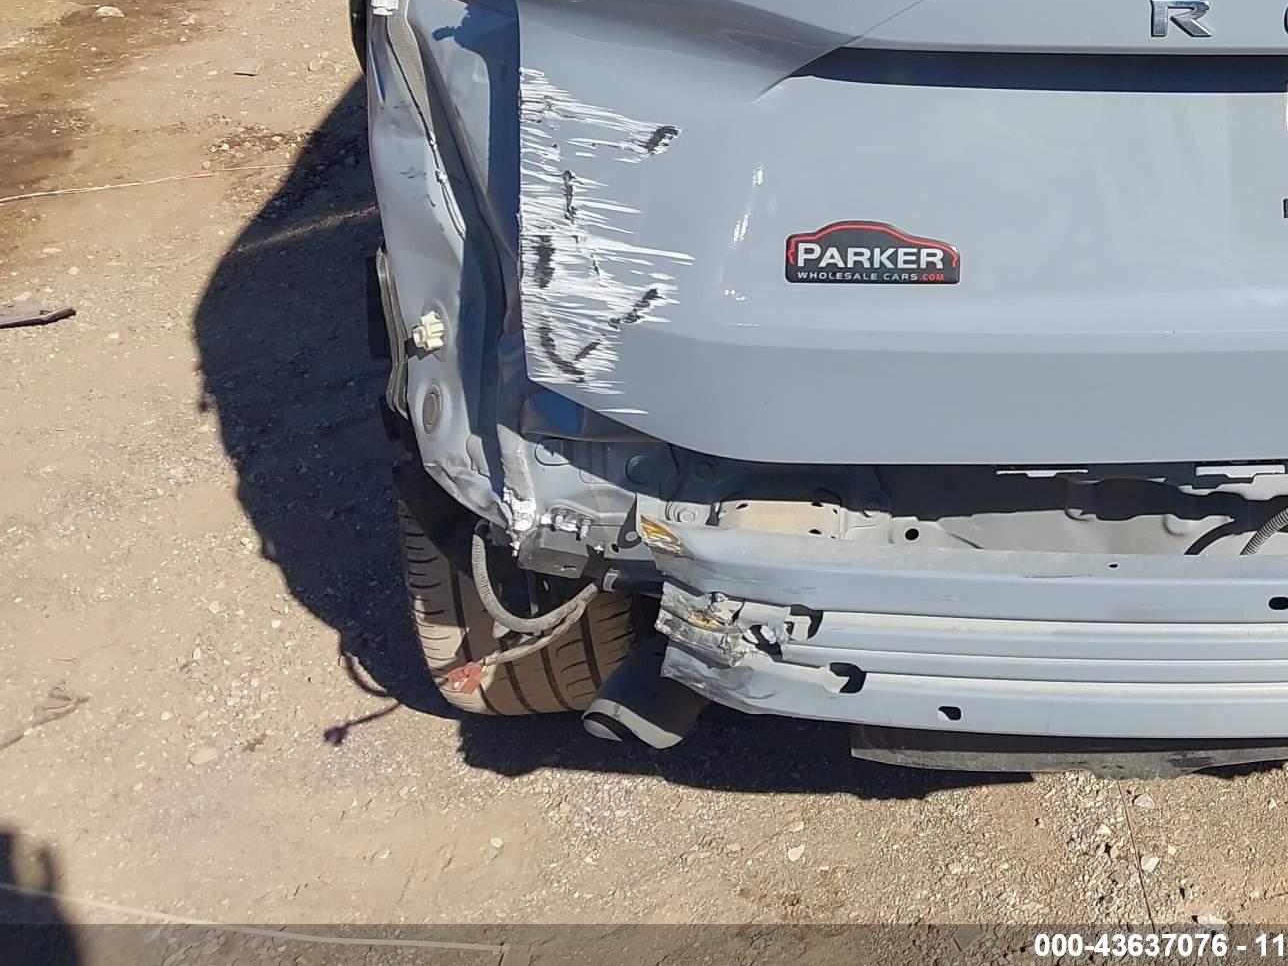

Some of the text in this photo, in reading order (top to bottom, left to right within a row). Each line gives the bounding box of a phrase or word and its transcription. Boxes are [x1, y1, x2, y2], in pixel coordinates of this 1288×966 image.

[797, 242, 944, 269] PARKER
[797, 272, 945, 282] WHOLESALE CARS.COM
